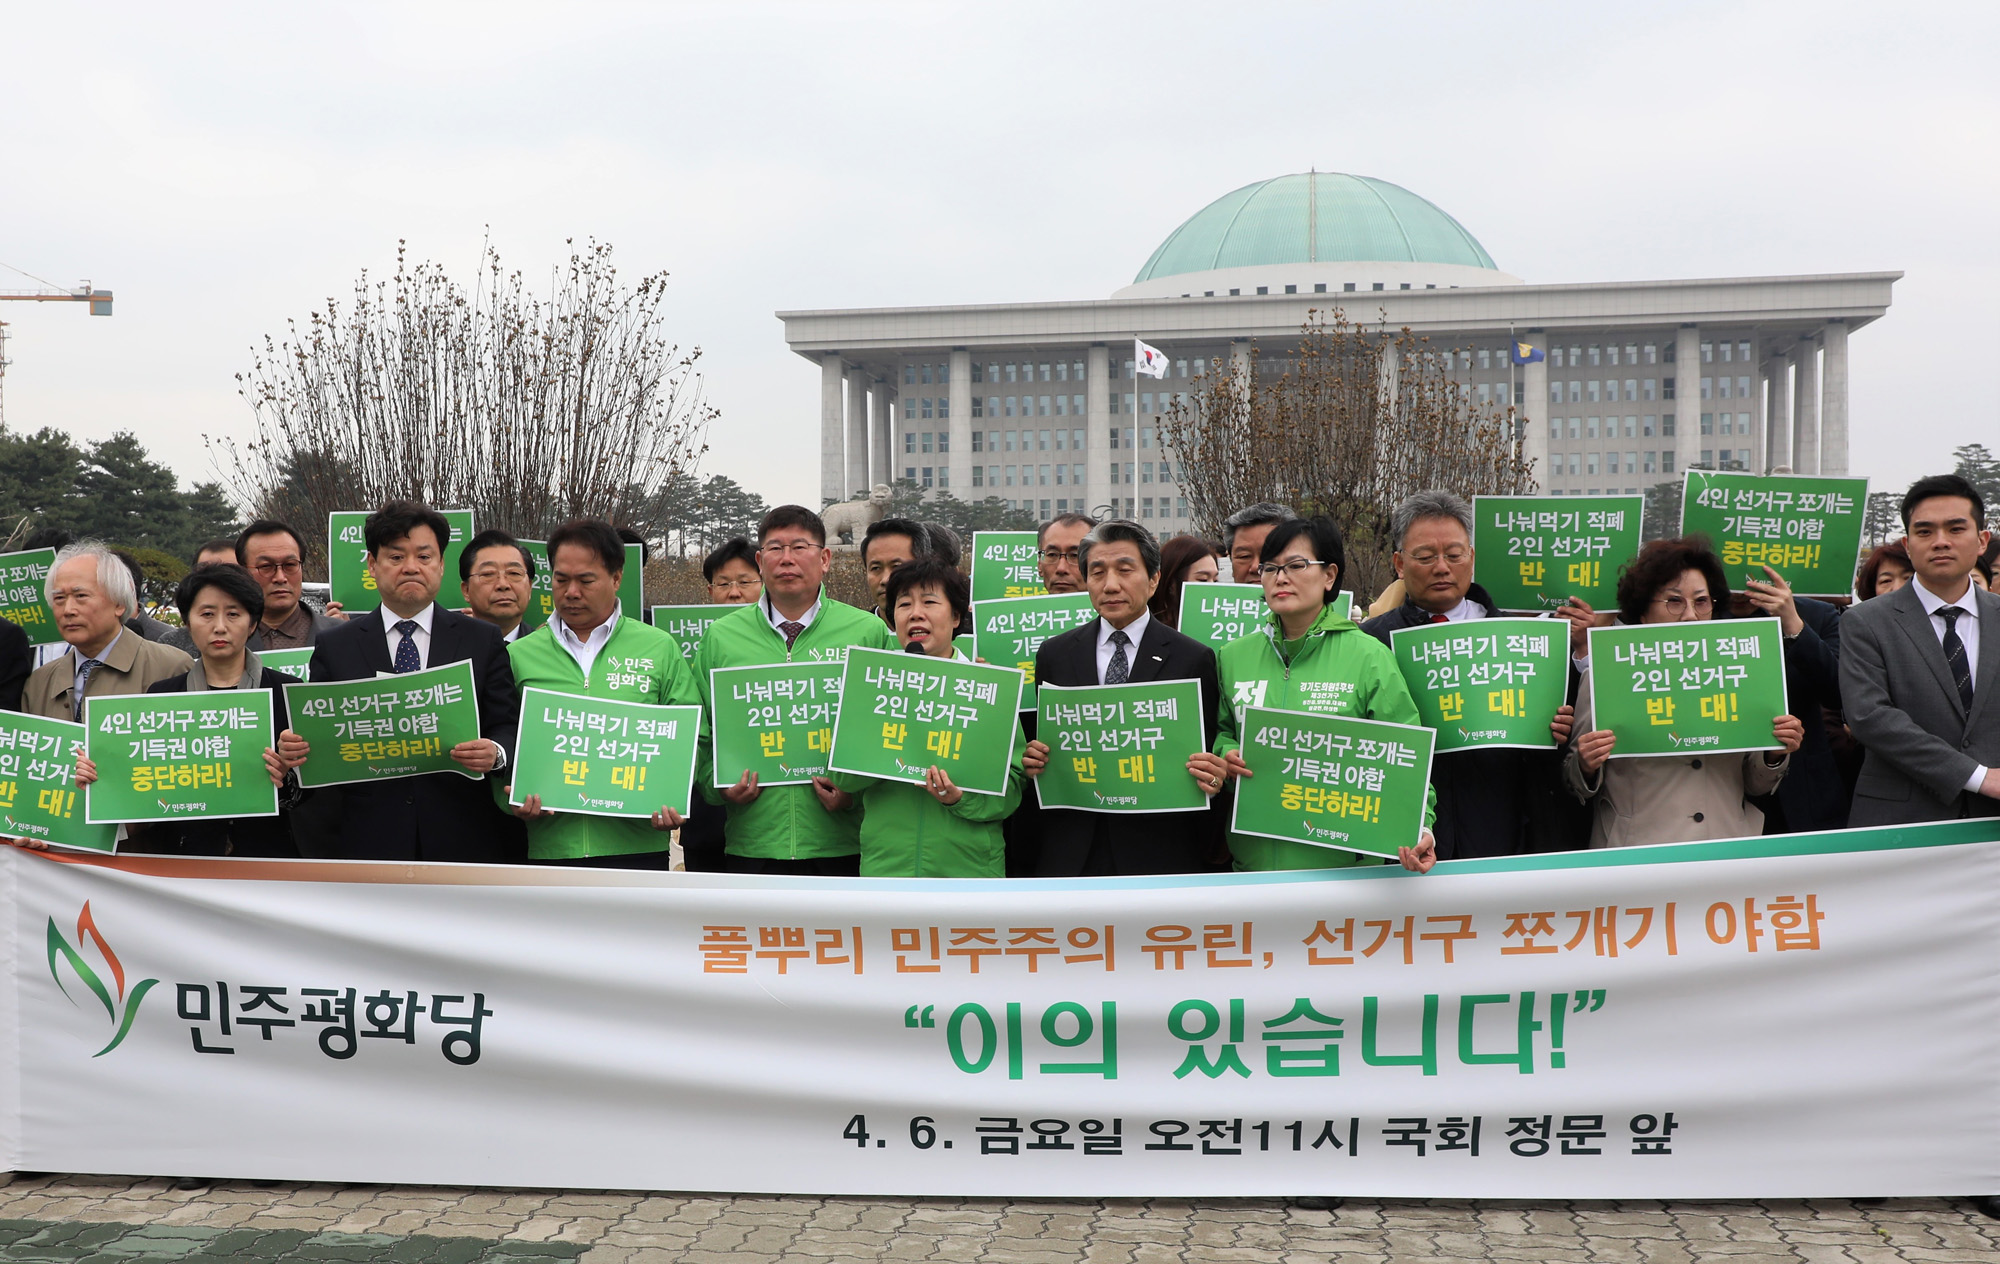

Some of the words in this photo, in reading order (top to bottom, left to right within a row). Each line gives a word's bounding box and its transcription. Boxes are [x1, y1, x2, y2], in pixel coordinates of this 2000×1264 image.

[1697, 488, 1729, 509] 4인
[1733, 490, 1793, 512] 선거구
[1796, 493, 1853, 514] 쪼개는
[1495, 511, 1580, 532] 나눠먹기
[1587, 510, 1624, 532] 적폐
[1722, 516, 1782, 538] 기득권
[1786, 519, 1825, 540] 야합
[340, 526, 362, 543] 4인
[1508, 537, 1542, 556] 2인
[1551, 536, 1611, 557] 선거구
[983, 545, 1007, 561] 4인
[1011, 545, 1038, 562] 선거
[1722, 541, 1821, 569] 중단하라!
[11, 563, 49, 582] 쪼개는
[1520, 562, 1545, 586] 반
[1568, 562, 1599, 587] 대!
[10, 585, 38, 604] 야합
[0, 605, 46, 626] 하라!
[670, 619, 714, 637] 나눠
[986, 614, 1014, 633] 4인
[1019, 610, 1071, 631] 선거구
[1211, 622, 1244, 641] 2인
[1013, 636, 1056, 656] 기득
[1412, 635, 1497, 664] 나눠먹기
[1506, 635, 1549, 658] 적폐
[1614, 638, 1708, 666] 나눠먹기
[1716, 636, 1760, 660] 적폐
[625, 658, 654, 673] 민주
[1426, 665, 1460, 690] 2인
[1467, 662, 1536, 685] 선거구
[1632, 669, 1671, 692] 2인
[1678, 665, 1748, 690] 선거구
[606, 673, 651, 693] 평화당
[733, 678, 815, 703] 나눠먹기
[823, 677, 843, 697] 적
[865, 666, 946, 697] 나눠먹기
[953, 678, 998, 705] 적폐
[302, 698, 335, 717] 4인
[340, 692, 400, 716] 선거구
[404, 683, 463, 709] 쪼개는
[874, 694, 909, 719] 2인
[914, 700, 978, 728] 선거구
[1046, 702, 1125, 726] 나눠먹기
[1133, 698, 1178, 722] 적폐
[1439, 692, 1464, 721] 반
[1488, 689, 1526, 717] 대!
[1646, 697, 1675, 726] 반
[1700, 693, 1738, 722] 대!
[100, 712, 131, 734] 4인
[136, 711, 195, 733] 선거구
[199, 707, 258, 729] 쪼개는
[334, 718, 394, 739] 기득권
[399, 713, 438, 735] 야합
[543, 707, 628, 737] 나눠먹기
[635, 719, 677, 739] 적폐
[748, 705, 781, 727] 2인
[0, 727, 62, 757] 눠먹기
[760, 731, 785, 757] 반
[807, 728, 831, 753] 대
[882, 722, 907, 750] 반
[927, 730, 962, 760] 대!
[1059, 730, 1092, 752] 2인
[1098, 727, 1165, 752] 선거구
[1255, 726, 1287, 749] 4인
[1293, 730, 1352, 757] 선거구
[1356, 739, 1416, 767] 쪼개는
[1472, 729, 1507, 740] 민주평화당
[1684, 735, 1719, 746] 민주평화당
[129, 737, 187, 761] 기득권
[191, 736, 231, 758] 야합
[339, 737, 441, 761] 중단하라!
[553, 734, 590, 756] 2인
[596, 739, 661, 763] 선거구
[0, 754, 20, 776] 인
[26, 759, 76, 785] 선거
[131, 763, 232, 792] 중단하라!
[563, 760, 589, 785] 반
[611, 766, 646, 791] 대!
[793, 766, 824, 776] 민주평화당
[908, 766, 927, 776] 민주평
[1073, 756, 1097, 783] 반
[1118, 755, 1155, 783] 대!
[1282, 757, 1340, 785] 기득권
[1345, 766, 1385, 792] 야합
[38, 789, 75, 818] 대!
[172, 802, 206, 812] 민주평화당
[591, 799, 624, 809] 민주평화당
[1106, 796, 1137, 805] 민주평화당
[1281, 783, 1381, 823] 중단하라!
[18, 822, 49, 835] 민주평화당
[1316, 828, 1349, 841] 민주평화당
[698, 925, 863, 975] 풀뿌리
[891, 924, 1115, 974] 민주주의
[1141, 921, 1274, 970] 유린,
[1301, 914, 1478, 966] 선거구
[1500, 902, 1679, 958] 쪼개기
[1704, 894, 1825, 953] 야합
[175, 980, 494, 1066] 민주평화당
[904, 1000, 1119, 1081] “이의
[1167, 989, 1607, 1080] 있습니다!”
[843, 1114, 887, 1149] 4.
[908, 1115, 953, 1150] 6.
[974, 1116, 1123, 1156] 금요일
[1144, 1116, 1360, 1157] 오전11시
[1381, 1115, 1483, 1157] 국회
[1504, 1114, 1608, 1158] 정문
[1628, 1112, 1679, 1156] 앞
